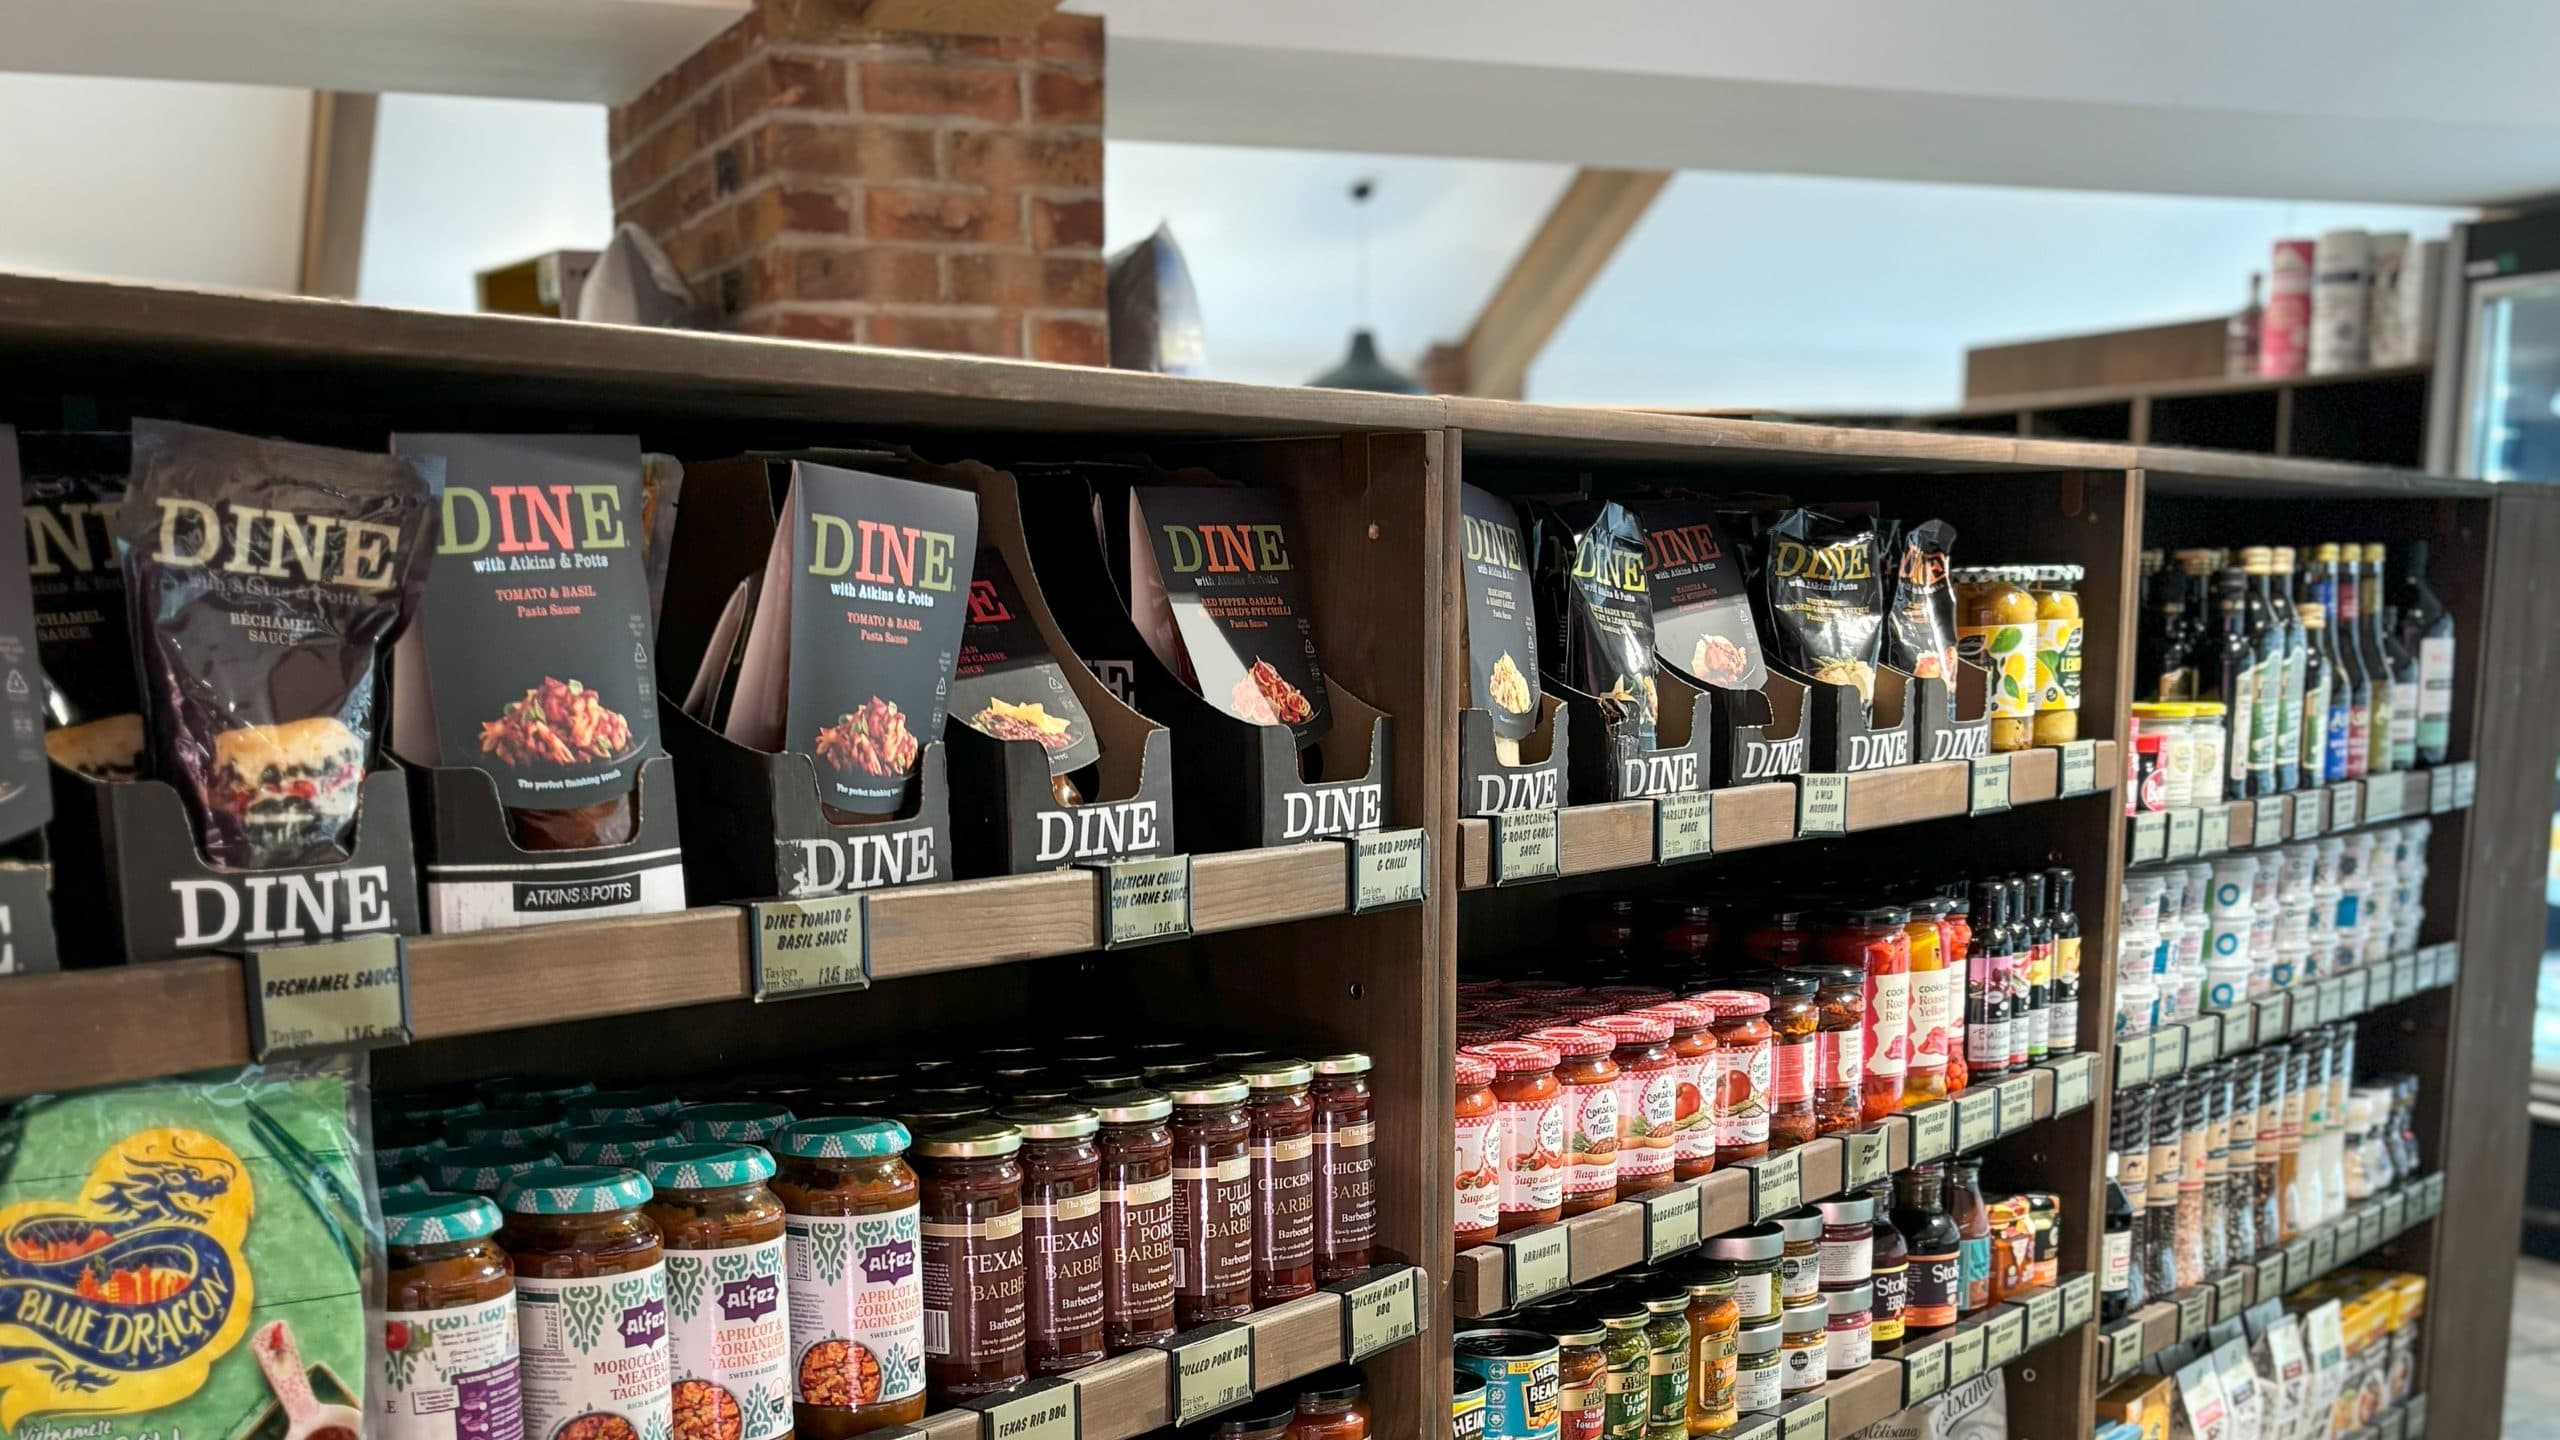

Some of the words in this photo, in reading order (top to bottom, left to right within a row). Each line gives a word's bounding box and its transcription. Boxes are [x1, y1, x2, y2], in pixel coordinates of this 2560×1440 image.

[437, 484, 626, 555] DINE
[151, 497, 401, 590] DINE
[809, 512, 955, 592] DINE
[1163, 524, 1290, 573] DINE
[1464, 515, 1522, 572] DINE
[473, 557, 506, 573] with
[510, 553, 556, 571] Atkins
[559, 553, 571, 569] &
[575, 552, 609, 569] Potts
[1573, 531, 1648, 592] DINE
[1775, 541, 1871, 580] DINE
[496, 588, 547, 602] TOMATO
[550, 588, 559, 600] &
[562, 585, 596, 599] BASIL
[830, 581, 856, 598] with
[859, 584, 894, 604] Atkins
[896, 587, 906, 599] &
[908, 589, 935, 608] Potts
[34, 611, 105, 632] CHAMEL
[517, 604, 547, 618] Pasta
[549, 603, 581, 616] Sauce
[847, 611, 886, 629] TOMATO
[897, 618, 923, 632] BASIL
[860, 629, 884, 643] Pasta
[885, 631, 909, 645] Sauce
[1848, 730, 1908, 772] DINE
[1931, 725, 1988, 763] DINE
[1742, 738, 1804, 779] DINE
[1623, 752, 1699, 798] DINE
[1477, 768, 1558, 815] DINE
[1283, 784, 1382, 839] DINE
[1036, 801, 1161, 862] DINE
[798, 827, 938, 894] DINE
[1360, 843, 1376, 858] DINE
[1378, 840, 1393, 855] RED
[1394, 837, 1421, 854] PEPPER
[1113, 874, 1155, 892] MEXICAN
[1157, 869, 1183, 886] CHILLI
[171, 865, 393, 947] DINE
[1130, 889, 1160, 906] CARNE
[765, 913, 798, 931] DINE
[800, 908, 842, 930] TOMATO
[777, 933, 813, 951] BASIL
[816, 928, 849, 947] SAUCE
[1218, 1182, 1251, 1203] PULL
[1515, 1174, 1538, 1187] Sugo
[1126, 1204, 1173, 1228] PULLE
[1035, 1226, 1099, 1255] TEXAS
[963, 1245, 1023, 1274] TEXAS
[855, 1296, 920, 1318] CORIANDER
[858, 1288, 912, 1305] APRICOT
[16, 1289, 94, 1346] BLUE
[99, 1267, 229, 1356] DRAGON
[854, 1313, 896, 1330] TAGINE
[716, 1323, 775, 1341] APRICOT
[776, 1320, 783, 1331] &
[712, 1332, 784, 1357] CORIANDER
[711, 1353, 758, 1370] TAGINE
[1180, 1358, 1210, 1377] PULLED
[1211, 1348, 1233, 1369] PORK
[1233, 1343, 1249, 1360] BBQ
[618, 1361, 668, 1387] MEATBAL
[729, 1369, 754, 1379] SWEET
[610, 1381, 654, 1401] TAGINE
[999, 1416, 1028, 1438] TEXAS
[1029, 1410, 1047, 1429] RIB
[1048, 1403, 1067, 1421] BBQ
[1453, 1407, 1485, 1438] HEIN
